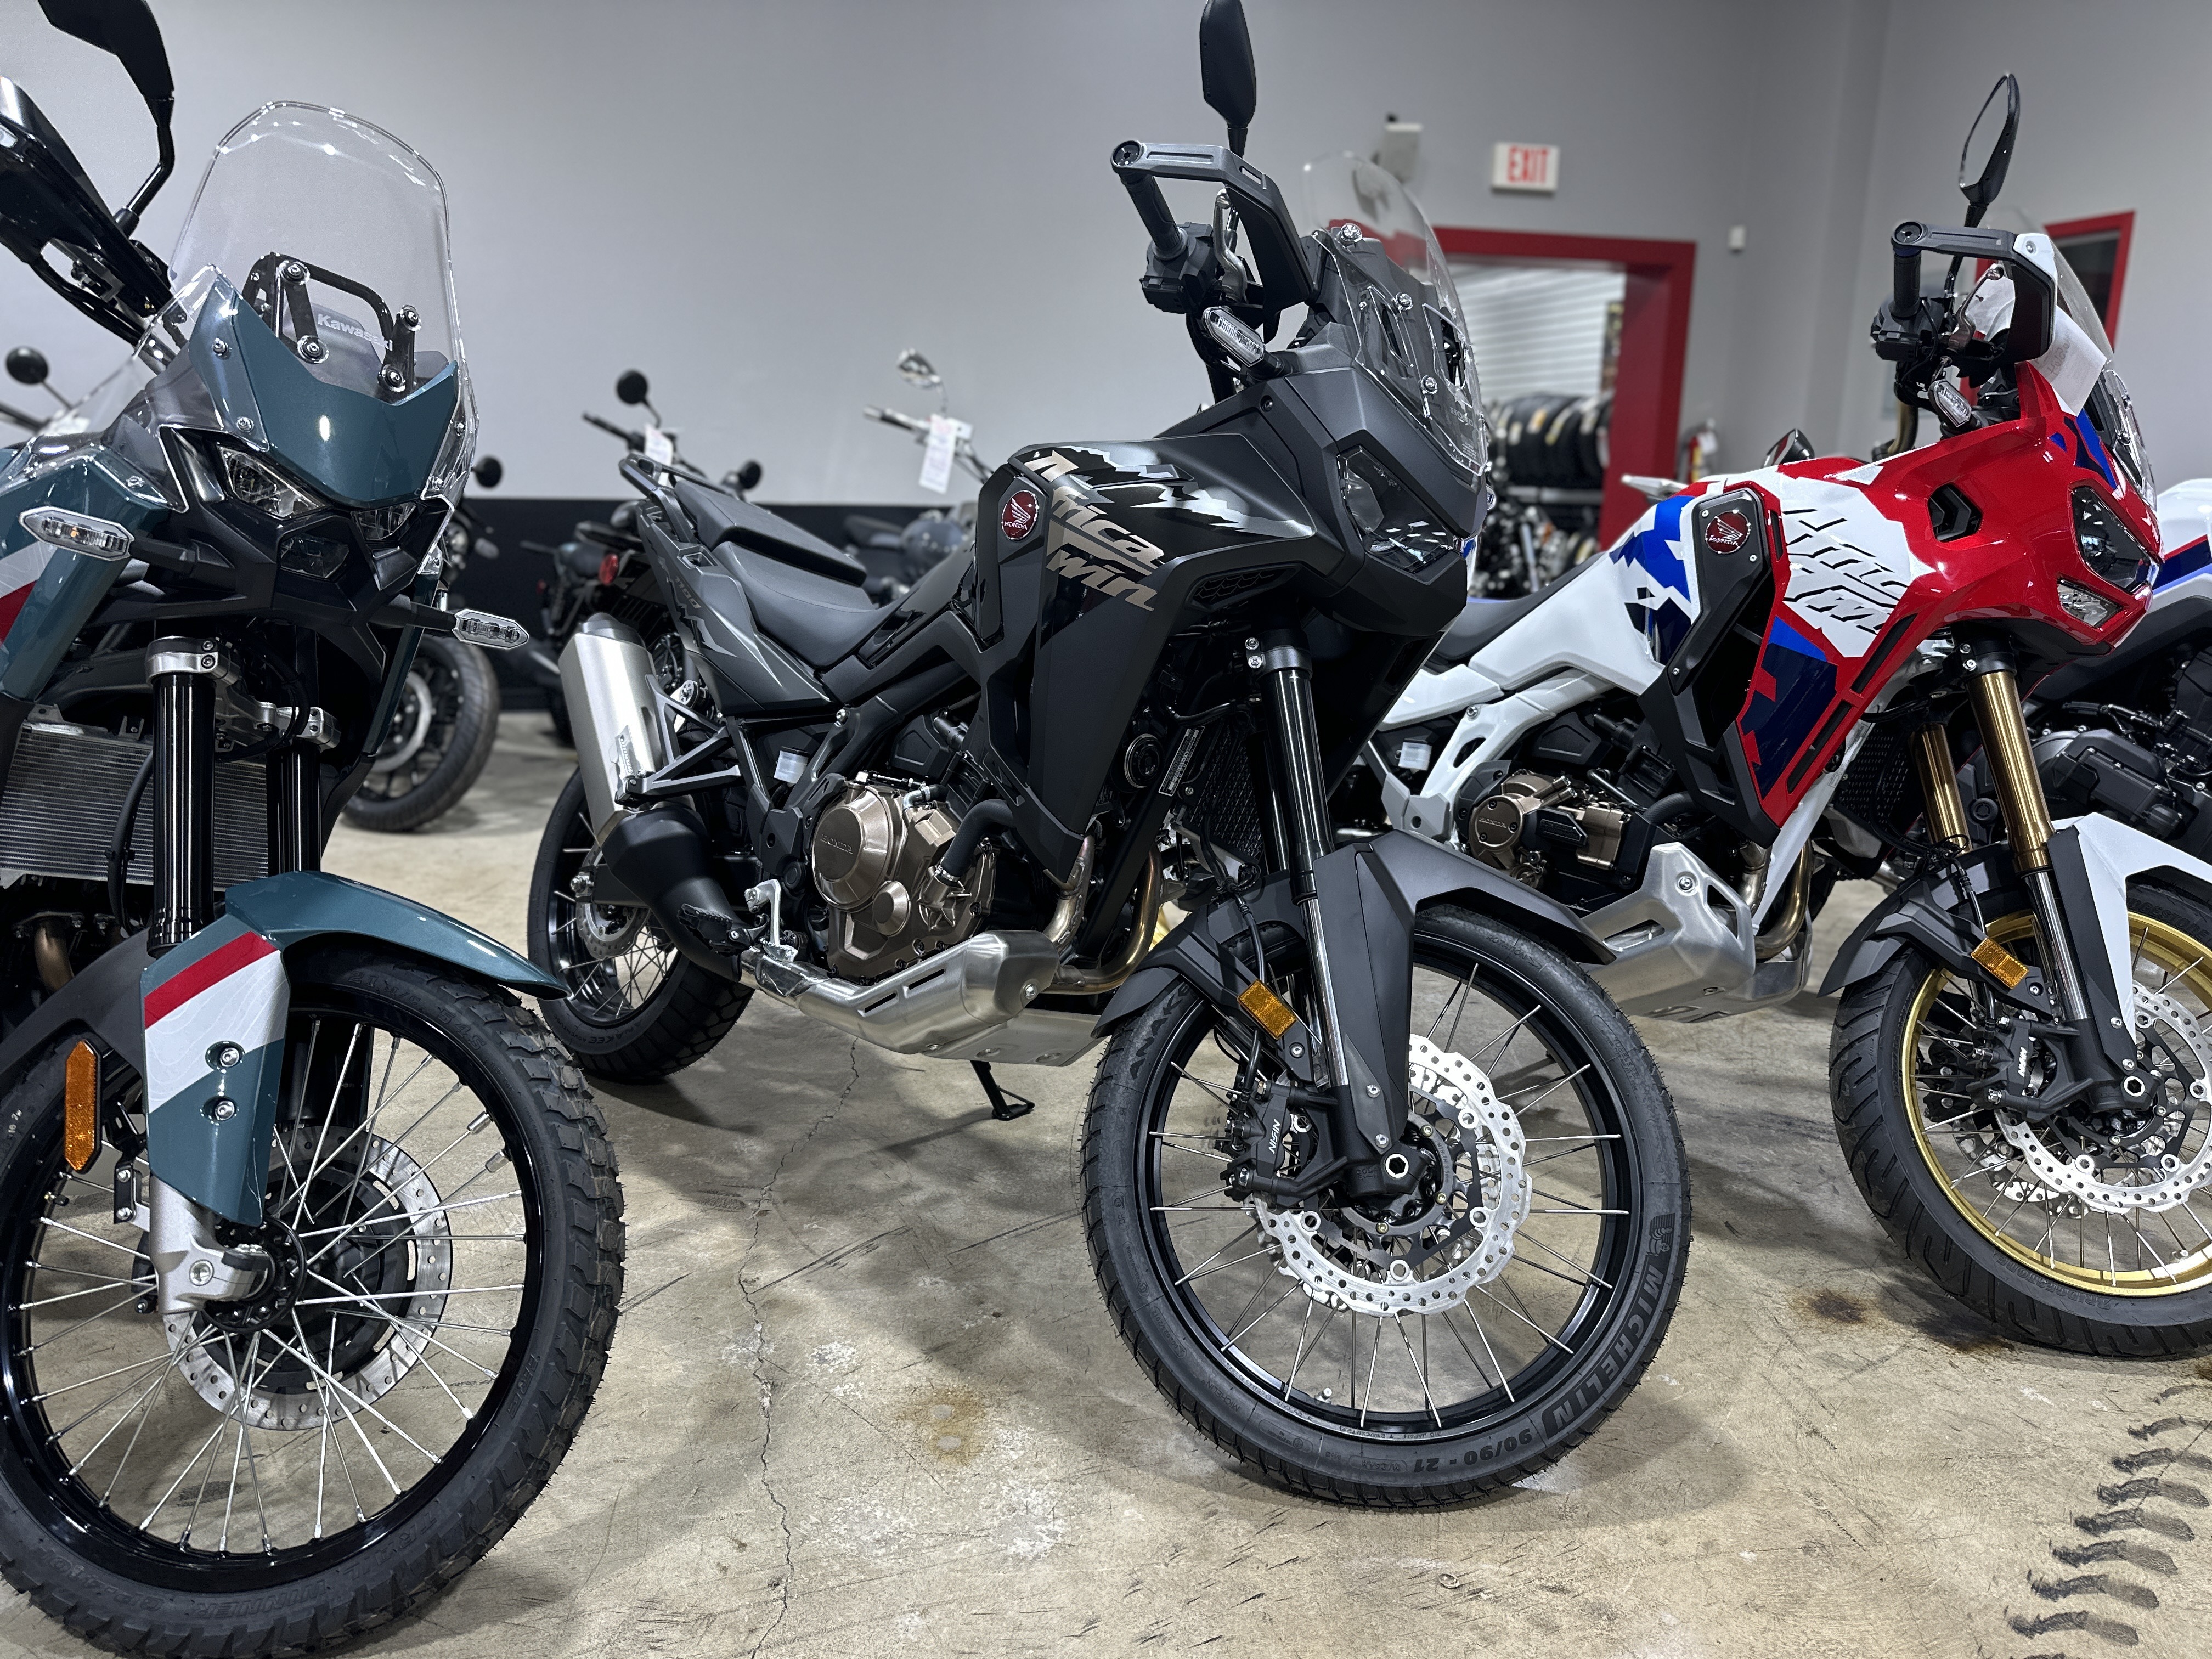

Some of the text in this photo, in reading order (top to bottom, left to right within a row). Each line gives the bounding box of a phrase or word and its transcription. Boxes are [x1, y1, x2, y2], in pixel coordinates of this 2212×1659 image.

[1508, 144, 1548, 183] EXIT
[318, 313, 393, 352] Kawasaki
[1003, 521, 1028, 531] HONDA
[1708, 534, 1739, 546] HONDA
[1479, 816, 1507, 829] HONDA
[820, 834, 854, 855] HONDA
[2127, 896, 2210, 940] DGESTONE
[1486, 935, 1528, 960] ROTATION
[1611, 1036, 1640, 1079] TUBELESS
[1267, 1119, 1281, 1154] NISSIN
[1997, 1257, 2112, 1311] BRIDGESTONE
[1554, 1266, 1668, 1427] MICHELIN
[1463, 1428, 1532, 1465] 90/90
[1414, 1457, 1440, 1474] 21
[193, 1580, 326, 1620] WINNER
